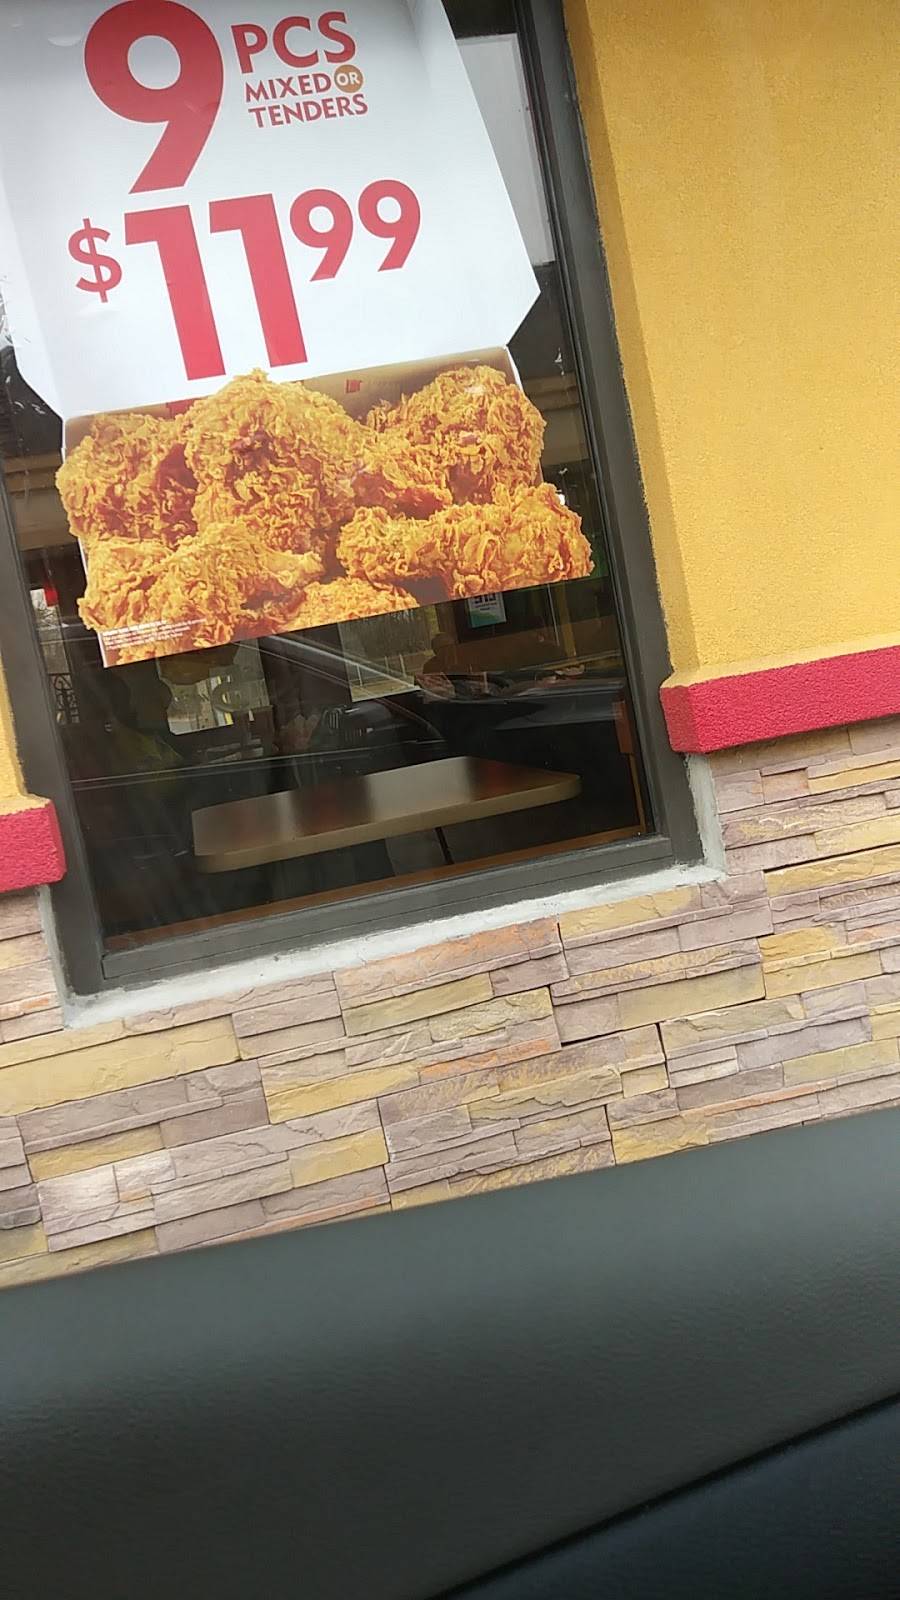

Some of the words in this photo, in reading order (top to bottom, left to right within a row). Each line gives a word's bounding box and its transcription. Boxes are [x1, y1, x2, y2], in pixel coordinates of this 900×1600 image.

[231, 11, 356, 74] PCS
[84, 0, 225, 193] 9
[244, 73, 332, 103] MIXED
[338, 70, 360, 87] OR
[249, 93, 368, 128] TENDERS
